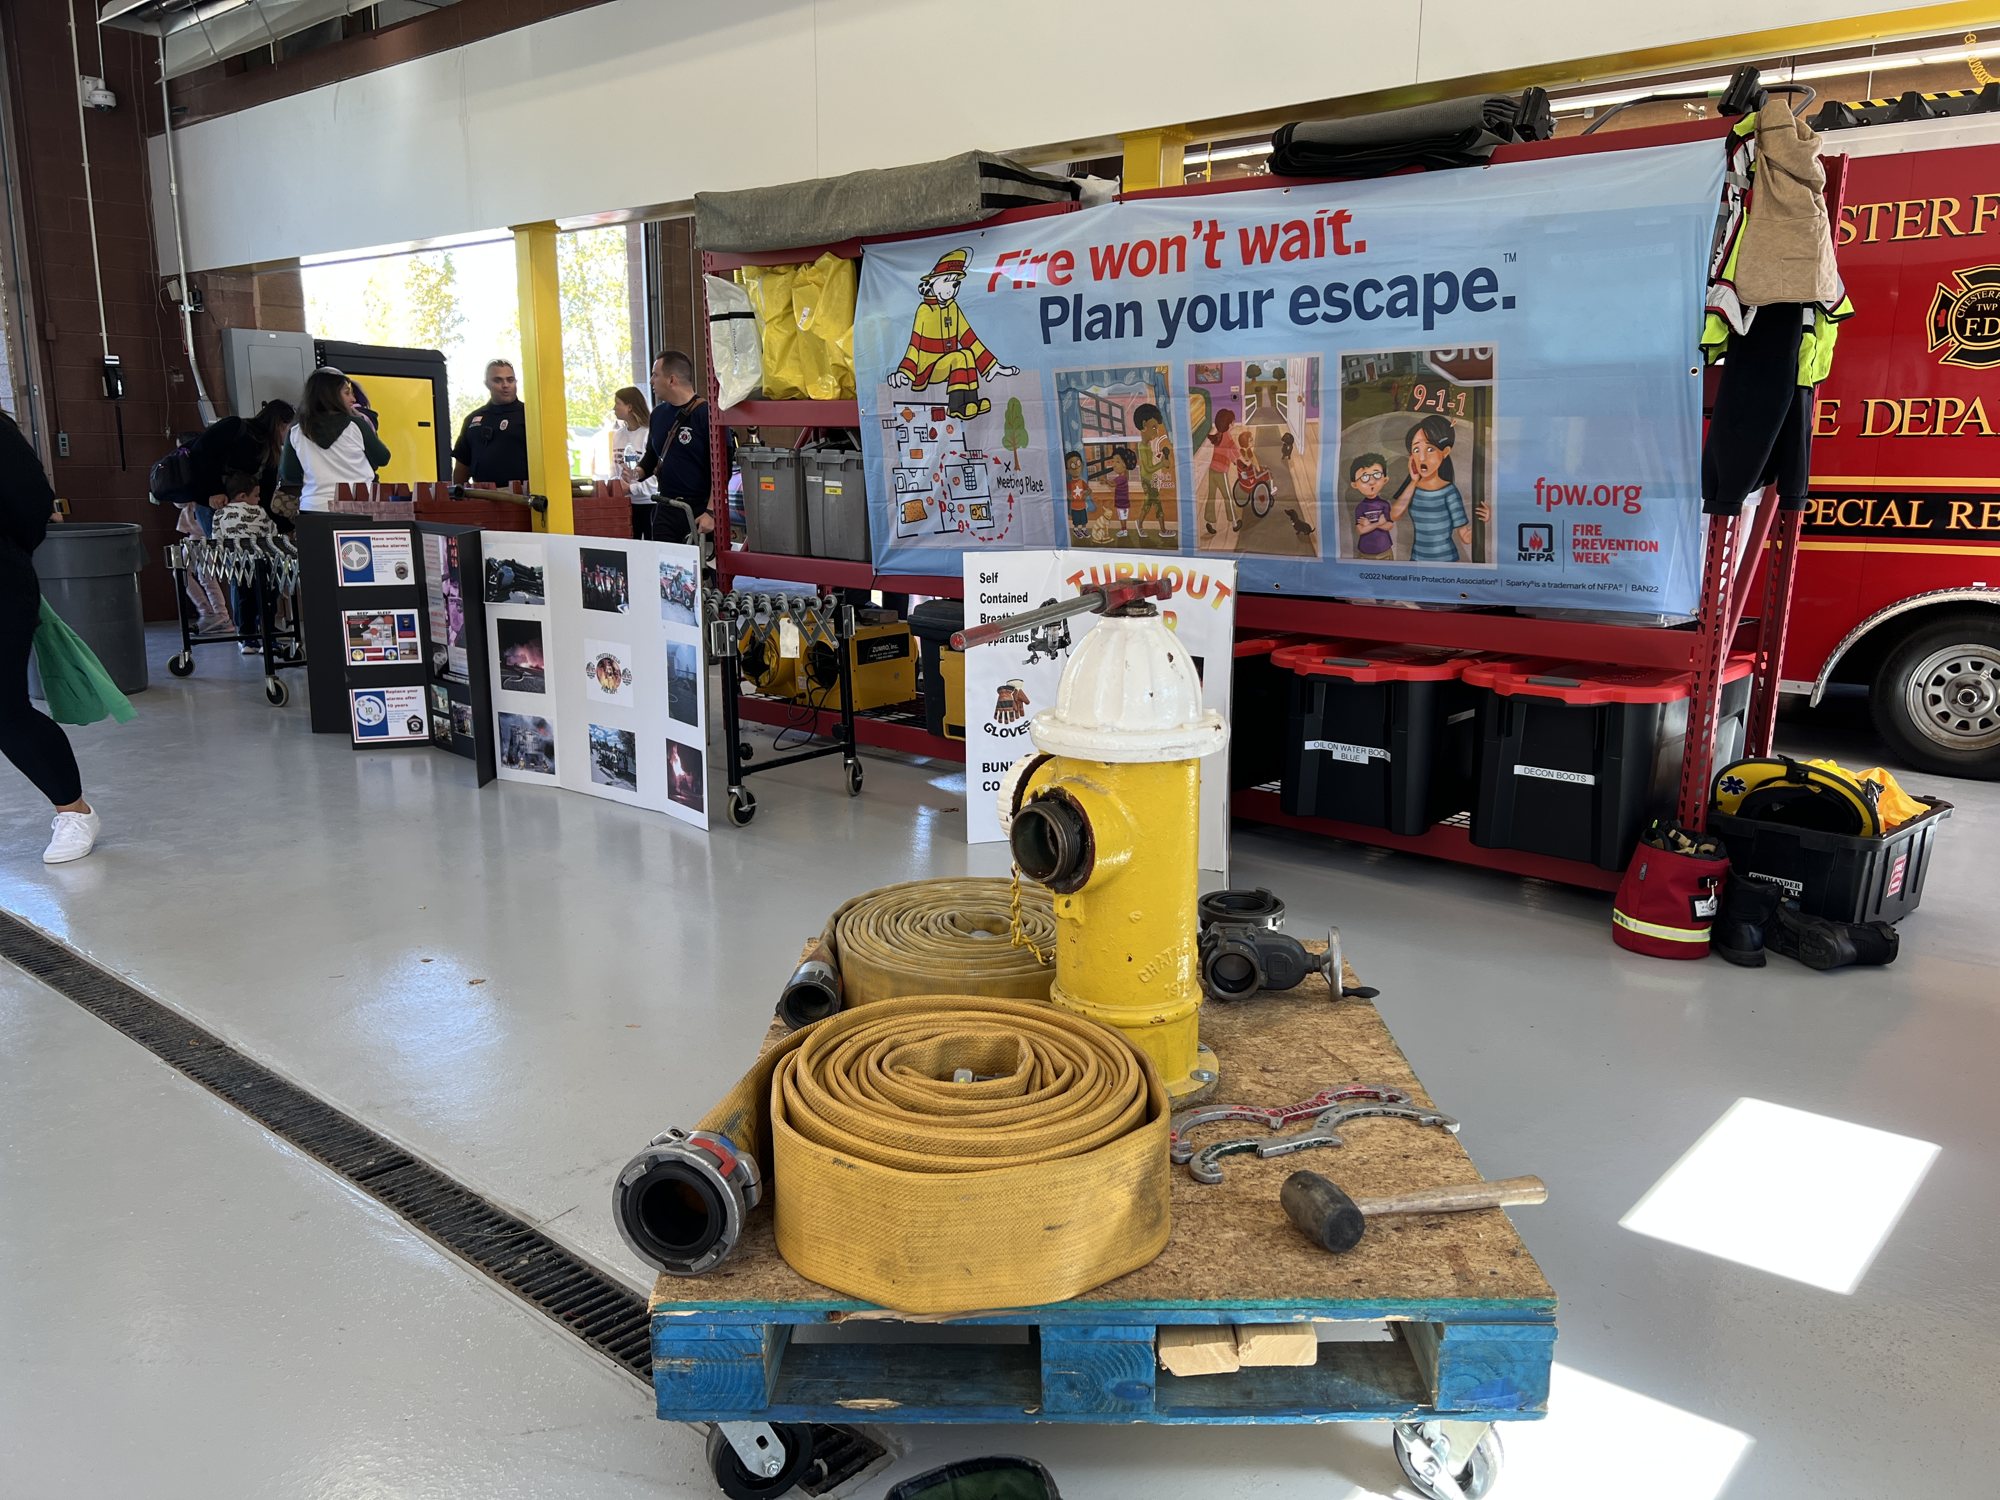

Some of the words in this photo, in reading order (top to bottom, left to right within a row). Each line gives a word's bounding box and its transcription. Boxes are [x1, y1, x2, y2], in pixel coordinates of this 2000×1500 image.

[987, 248, 1075, 293] Fire
[1238, 209, 1367, 266] wait.
[1976, 303, 1998, 311] TWP
[1040, 293, 1143, 345] Plan
[1156, 288, 1275, 349] your
[1413, 384, 1467, 416] 9-1-1
[1859, 396, 1997, 437] DEPA
[997, 476, 1024, 495] Meeting
[1025, 475, 1045, 493] Place
[1534, 477, 1643, 514] fpw.org
[1802, 498, 1933, 529] PECIAL
[1945, 501, 2000, 530] RE
[1572, 524, 1603, 537] FIRE
[1572, 538, 1659, 553] PREVENTION
[980, 572, 999, 584] Self
[1408, 574, 1420, 582] Fire
[1421, 575, 1455, 584] Protection
[1066, 561, 1233, 611] TURNOUT
[1547, 582, 1587, 590] trademark
[1631, 584, 1659, 593] BAN22
[980, 592, 1028, 604] Contained
[983, 720, 1031, 738] GLOVES
[1340, 745, 1367, 755] WATER
[1340, 752, 1360, 762] BLUE
[982, 761, 1013, 773] BUN
[1523, 766, 1554, 778] DECON
[1556, 771, 1587, 783] BOOTS
